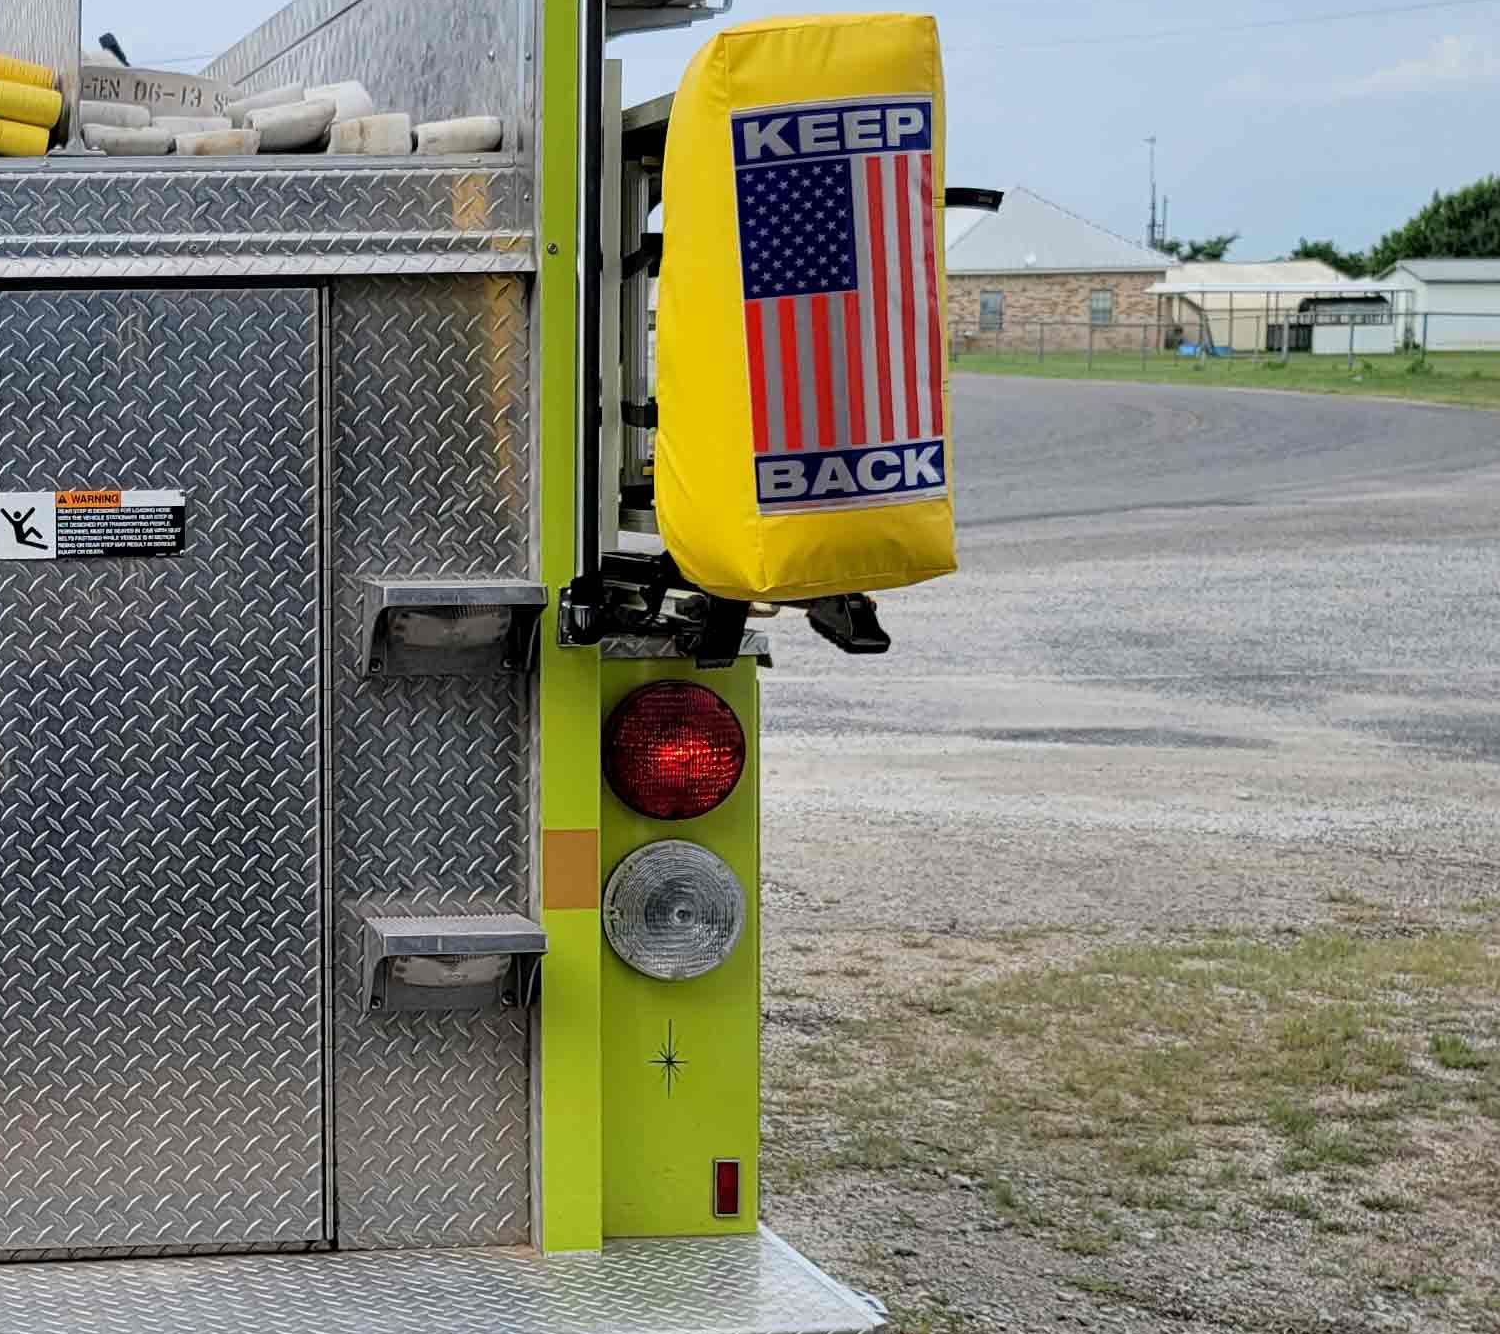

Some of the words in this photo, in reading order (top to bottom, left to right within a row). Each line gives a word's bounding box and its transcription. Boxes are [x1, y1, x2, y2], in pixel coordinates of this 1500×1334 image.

[743, 106, 924, 160] KEEP
[71, 494, 119, 504] WARNING
[757, 444, 943, 500] BACK
